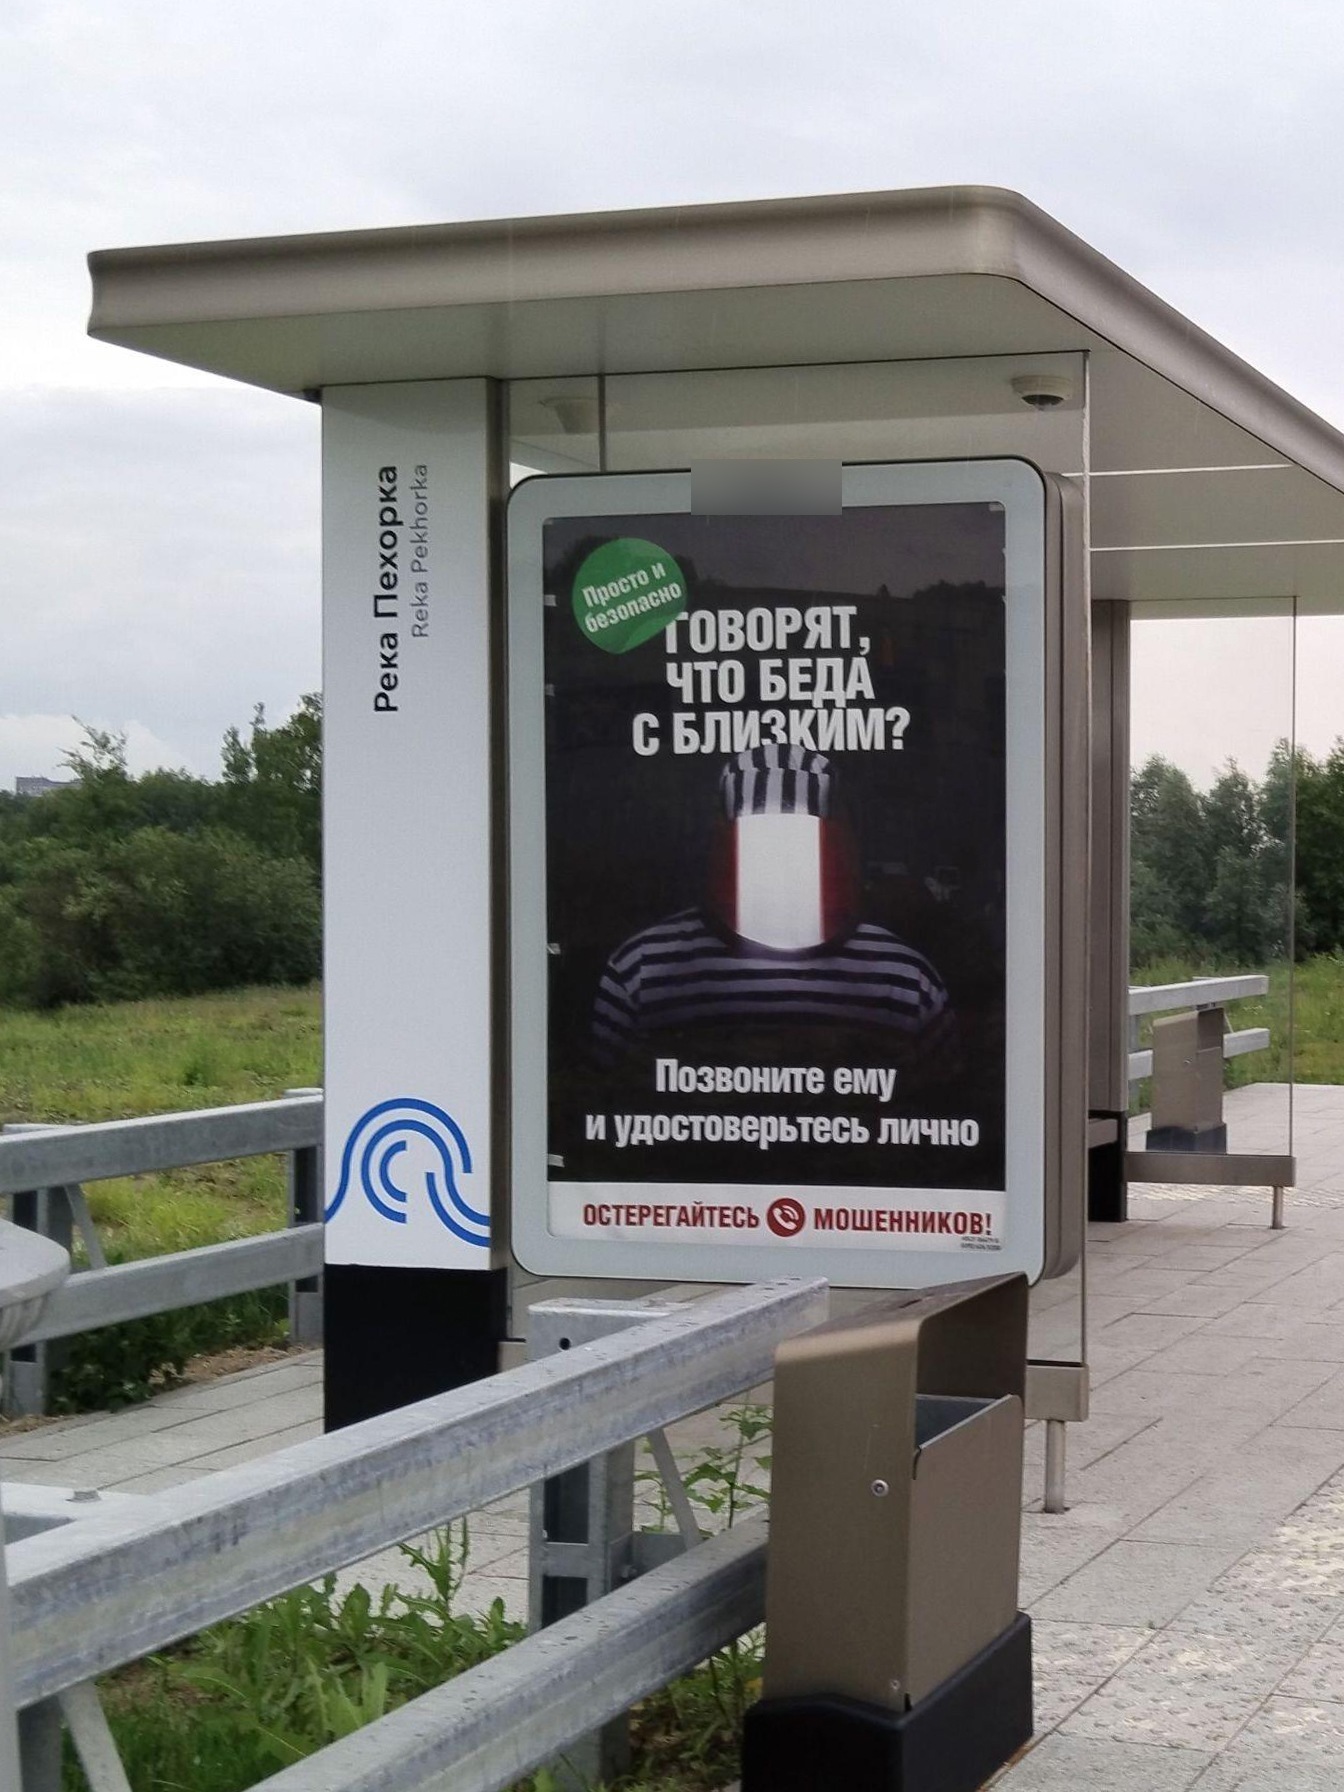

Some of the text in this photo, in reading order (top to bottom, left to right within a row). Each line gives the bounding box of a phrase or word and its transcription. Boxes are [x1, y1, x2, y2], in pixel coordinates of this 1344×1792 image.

[410, 463, 429, 638] Reka Pekhorka
[373, 465, 404, 712] Река Пехорка
[582, 562, 666, 607] Просто и
[584, 582, 682, 633] безопасно
[665, 605, 870, 656] ГОВОРЯТ,
[666, 656, 876, 708] ЧТО БЕДА
[632, 707, 911, 756] С БЛИЗКИМ?
[656, 1058, 897, 1103] Позвоните ему
[586, 1114, 980, 1150] и удостоверьтесь лично
[583, 1200, 992, 1236] ОСТЕРЕГАЙТЕСЬ МОШЕННИКОВ!
